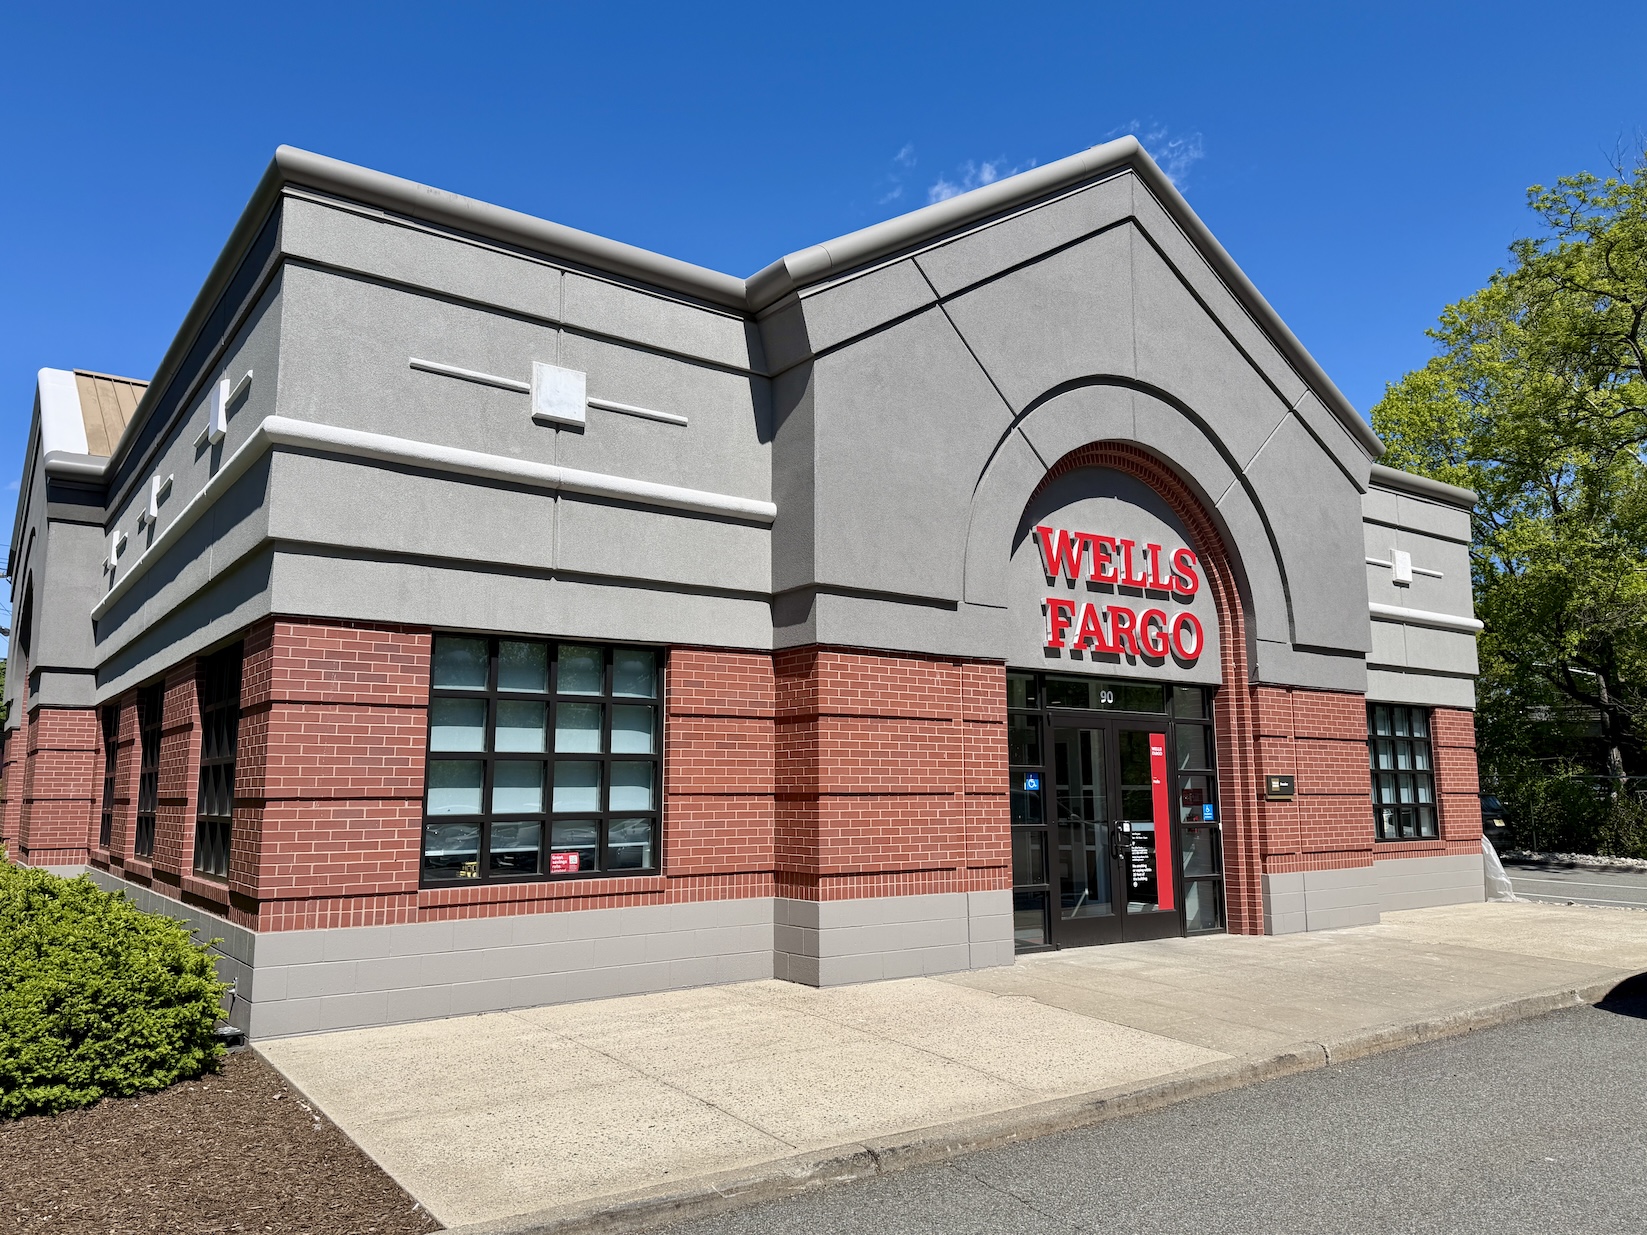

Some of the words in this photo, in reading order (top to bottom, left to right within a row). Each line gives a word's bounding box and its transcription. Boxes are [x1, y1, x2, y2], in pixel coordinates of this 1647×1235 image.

[1034, 525, 1199, 596] WELLS
[1042, 597, 1204, 660] FARGO
[1100, 690, 1114, 703] 90
